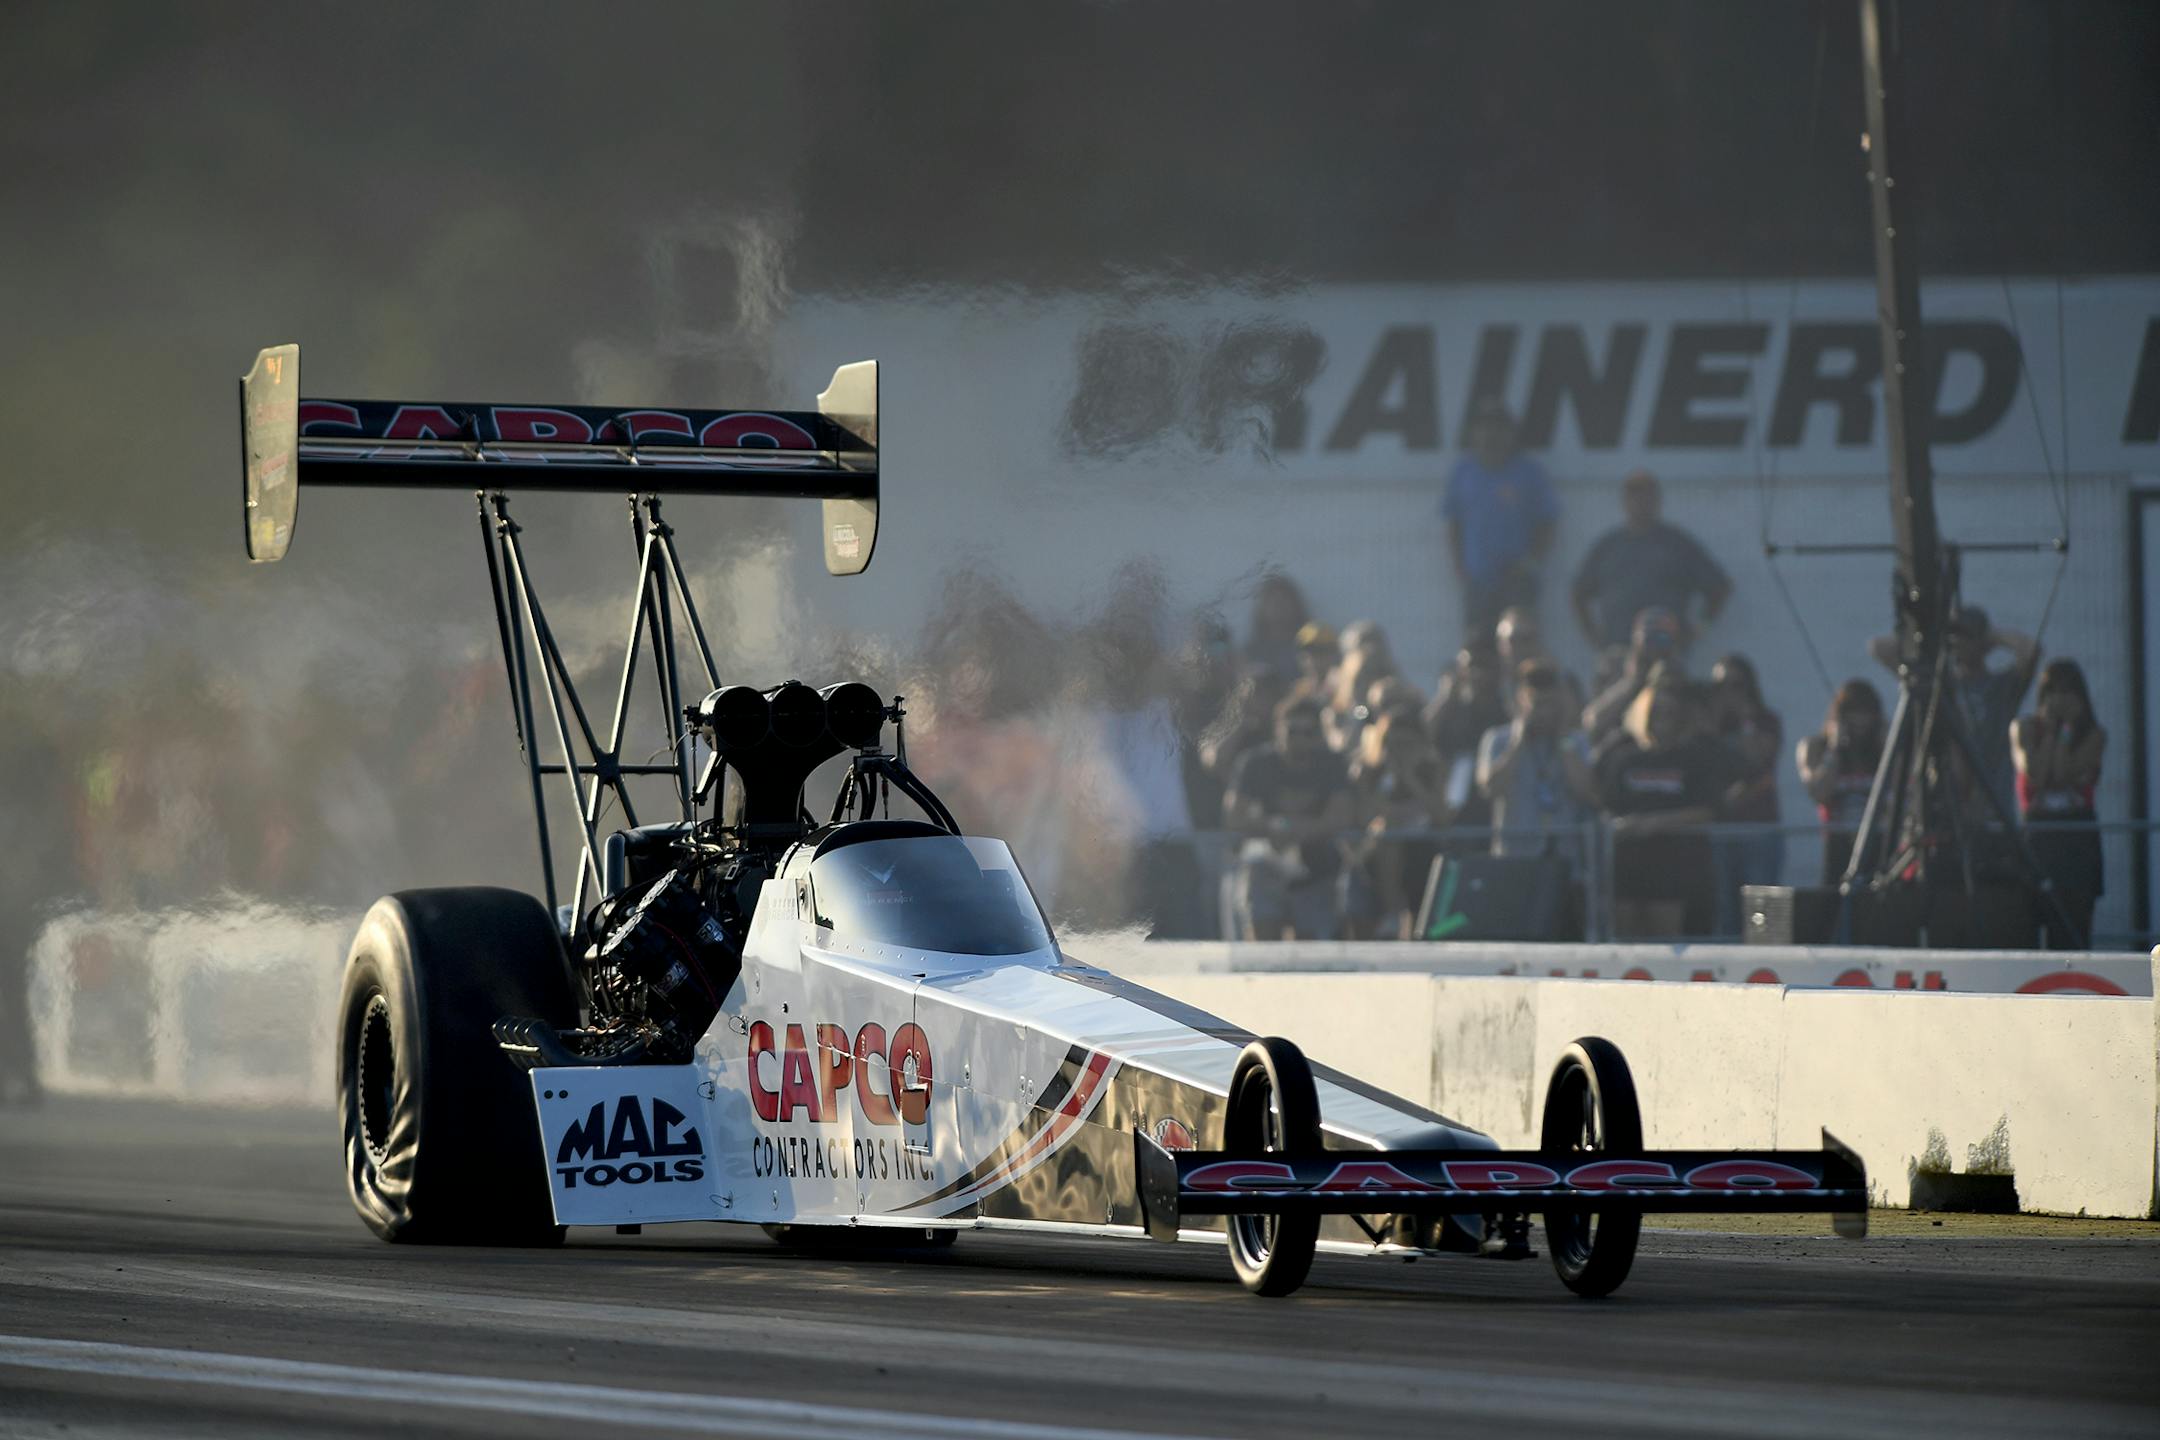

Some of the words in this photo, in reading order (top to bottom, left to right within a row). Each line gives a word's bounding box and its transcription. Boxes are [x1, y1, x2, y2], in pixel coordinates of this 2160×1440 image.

[299, 401, 817, 453] CAPCO
[748, 1020, 933, 1125] CAPCO
[556, 1095, 703, 1163] MAC
[556, 1159, 704, 1188] TOOLS
[753, 1136, 888, 1179] CONTRACTORS
[894, 1138, 934, 1181] INC.
[1183, 1159, 1821, 1193] CAPCO
